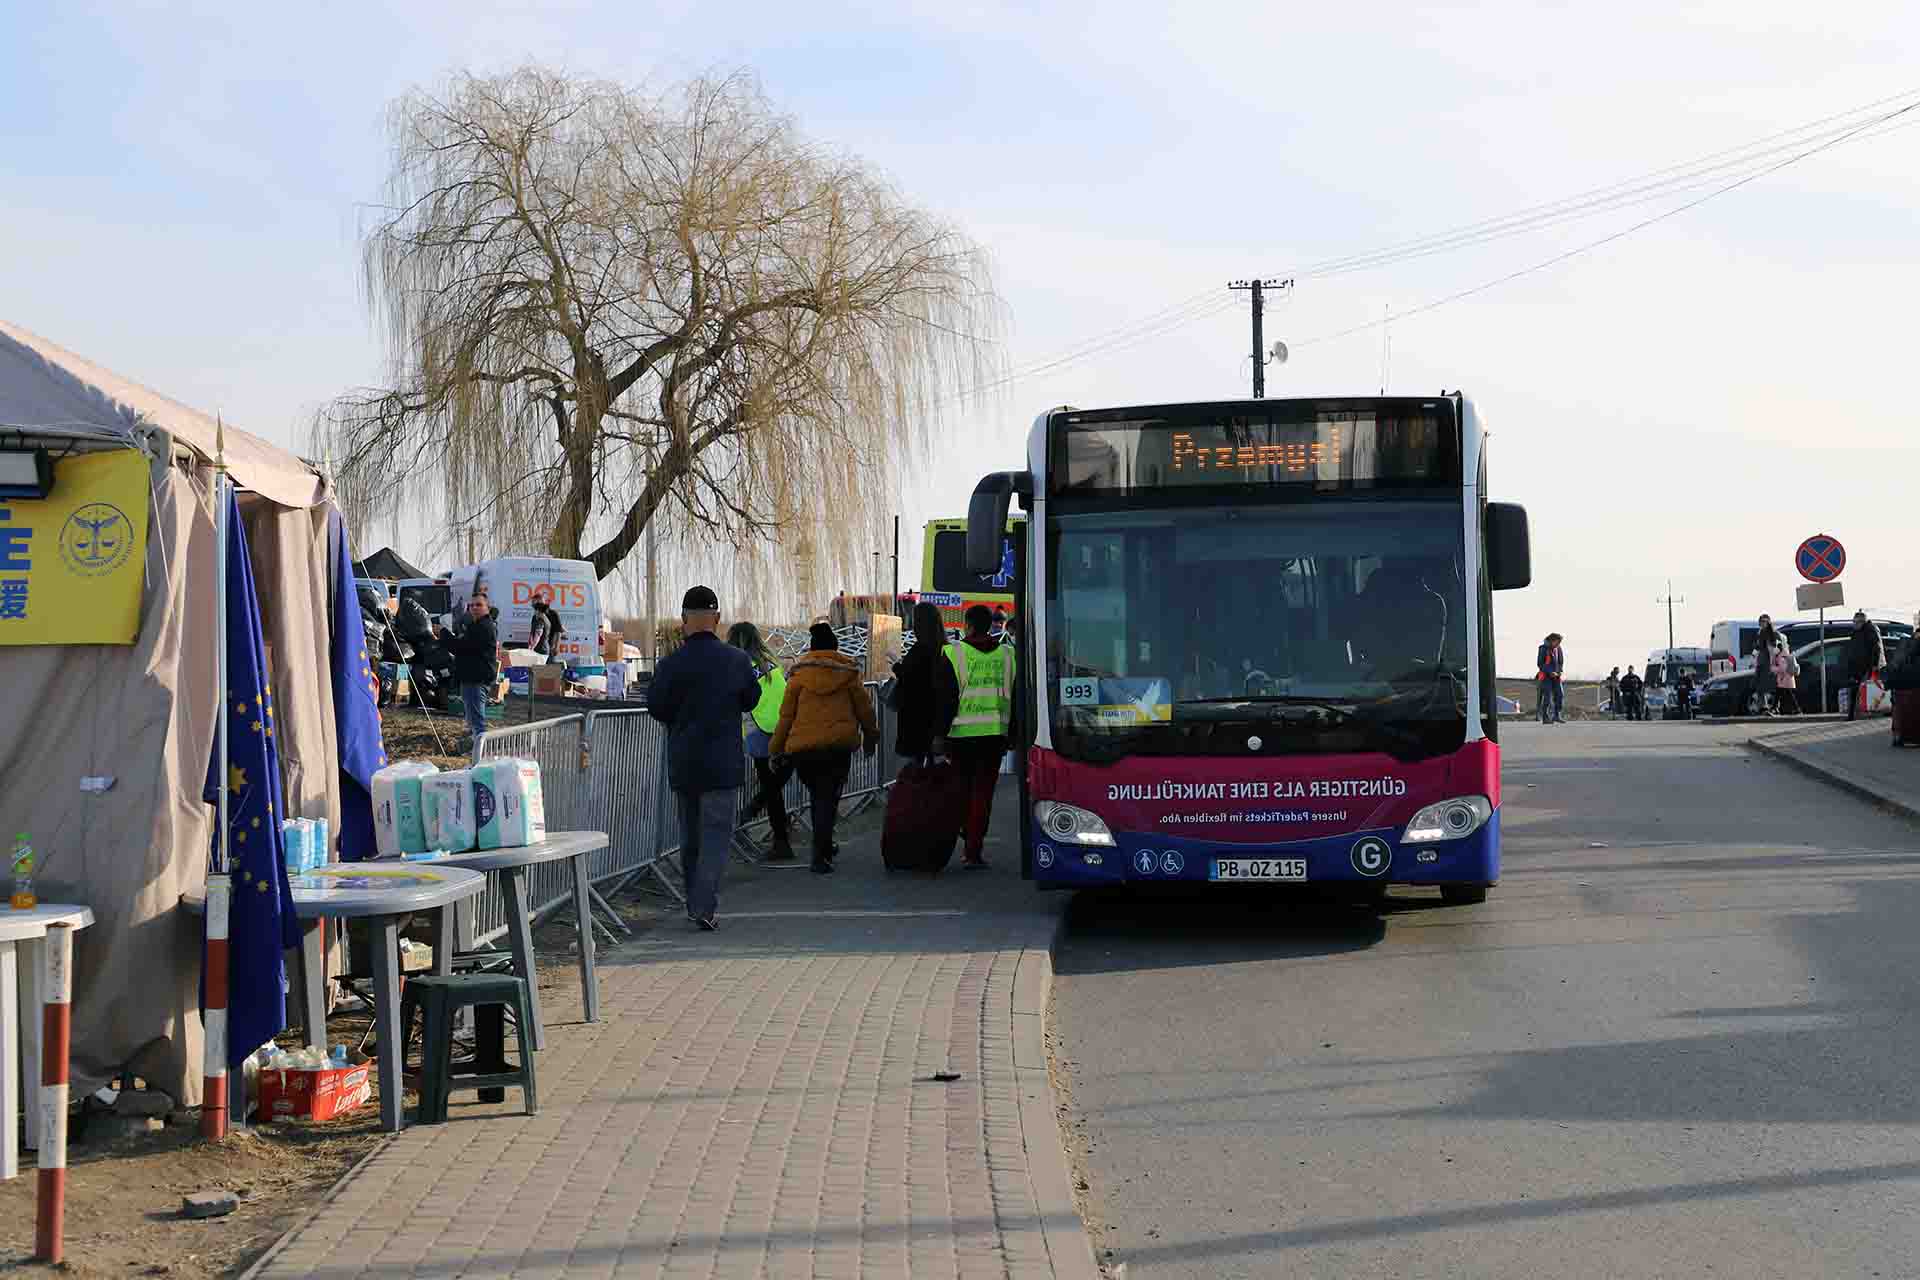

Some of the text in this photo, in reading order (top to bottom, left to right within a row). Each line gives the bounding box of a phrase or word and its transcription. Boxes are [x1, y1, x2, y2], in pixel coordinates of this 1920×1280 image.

[512, 582, 585, 607] DOTS
[1065, 685, 1093, 699] 993
[1361, 843, 1381, 869] G
[1218, 861, 1305, 877] PB OZ 115
